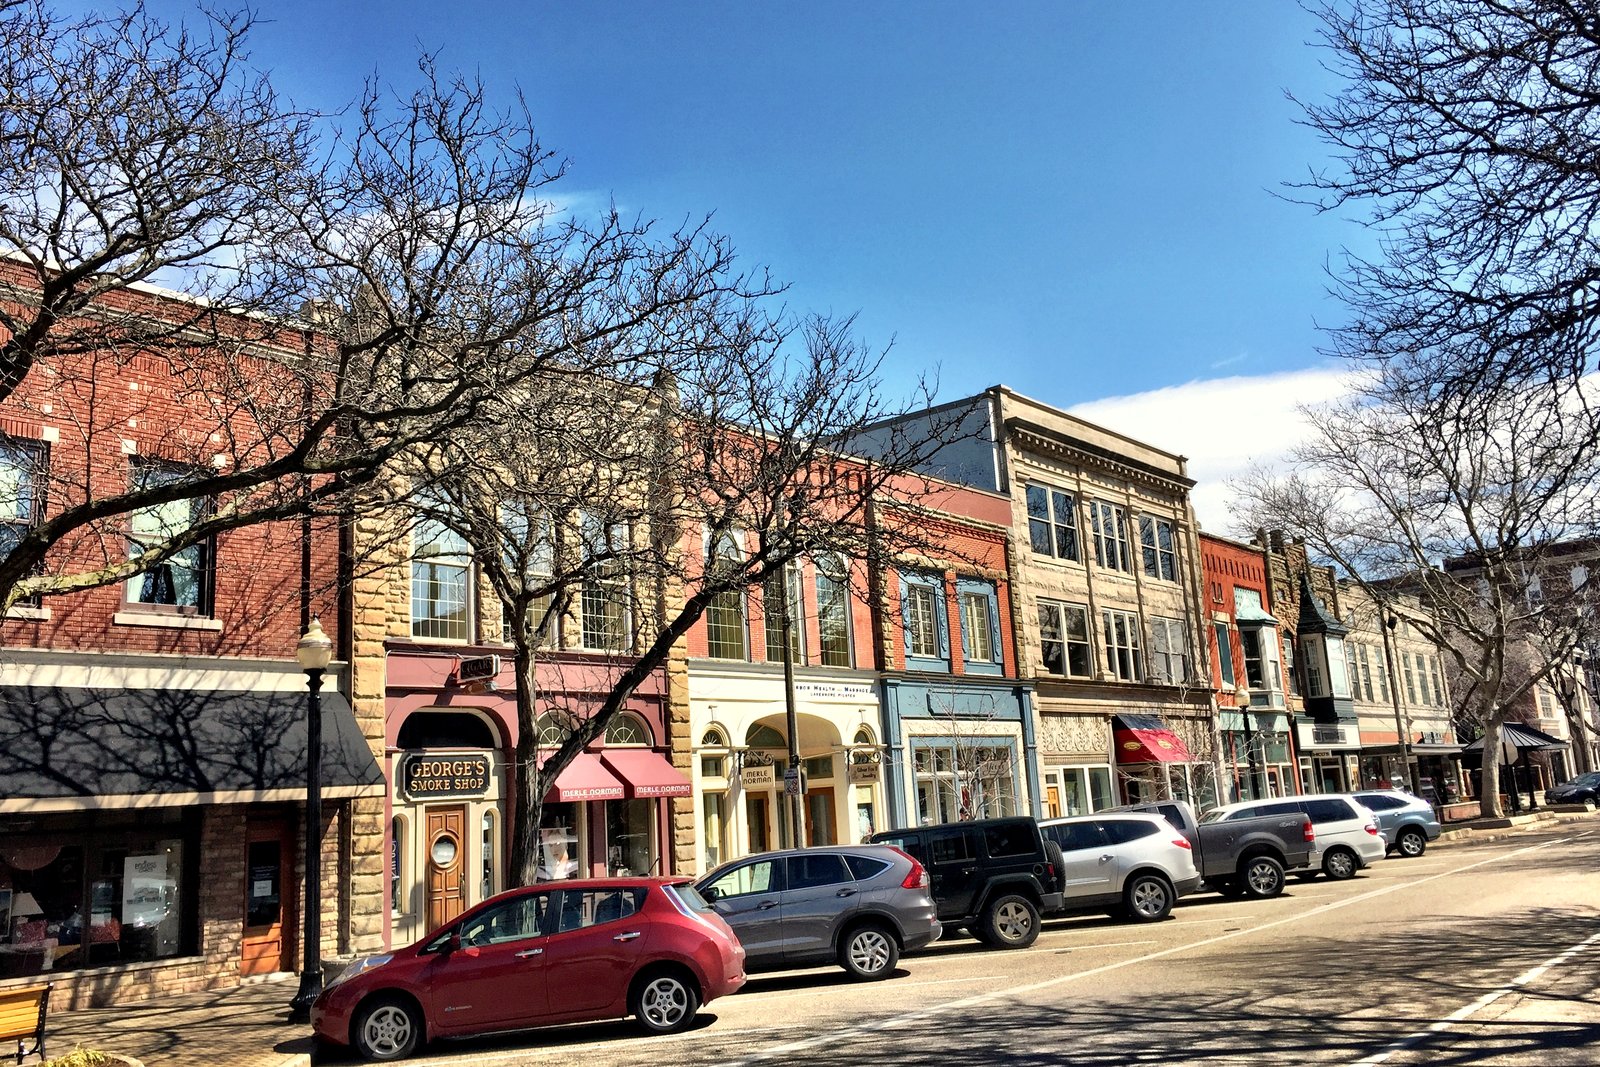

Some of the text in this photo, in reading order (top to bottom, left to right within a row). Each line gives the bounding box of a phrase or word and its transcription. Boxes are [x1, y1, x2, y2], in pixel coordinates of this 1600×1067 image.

[410, 761, 486, 778] GEORGE'S
[410, 778, 484, 792] SMOKE SHOP
[743, 777, 772, 785] NORMAN
[562, 789, 588, 797] MERLE
[589, 787, 623, 796] NORMAN
[636, 784, 691, 793] MERLE NORMAN
